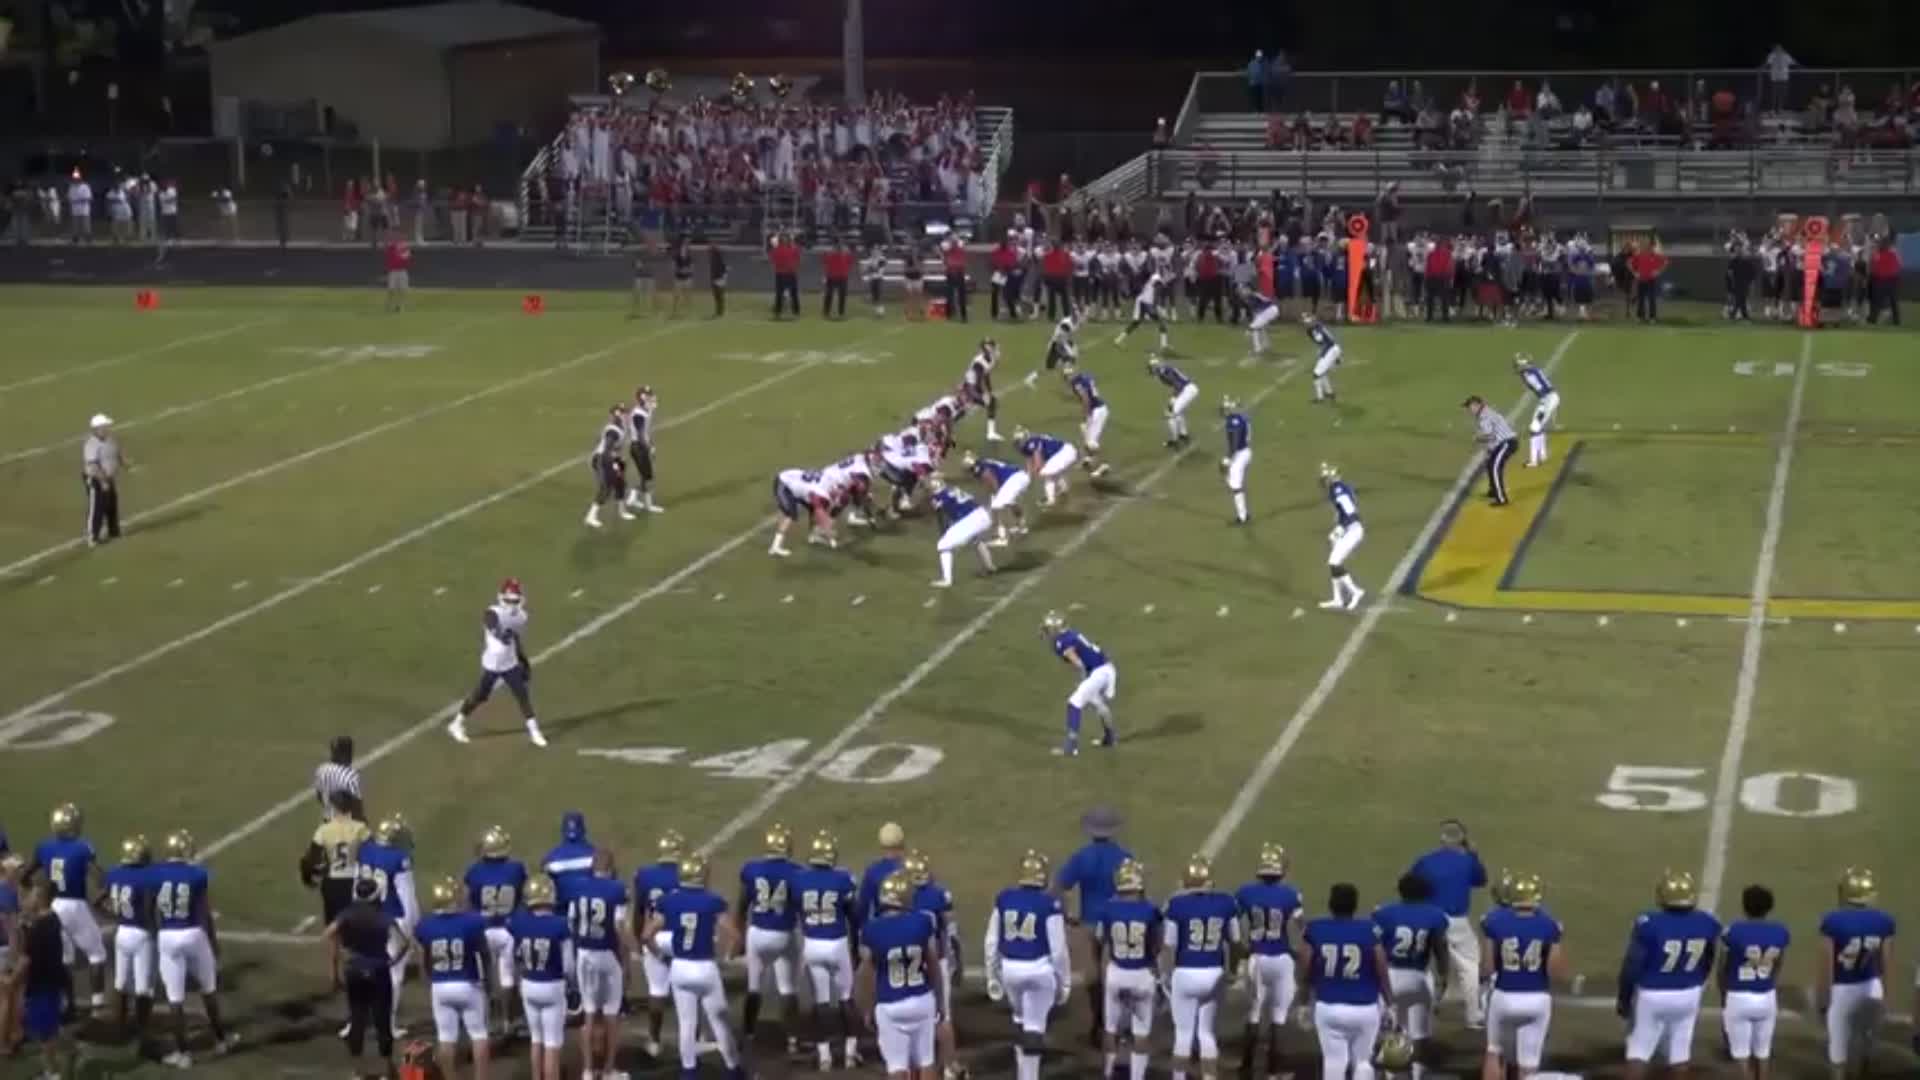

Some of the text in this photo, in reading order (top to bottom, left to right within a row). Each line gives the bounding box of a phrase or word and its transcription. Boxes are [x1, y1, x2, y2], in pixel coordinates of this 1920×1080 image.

[1595, 764, 1858, 818] 50
[680, 912, 698, 951] 7
[1321, 943, 1362, 980] 72
